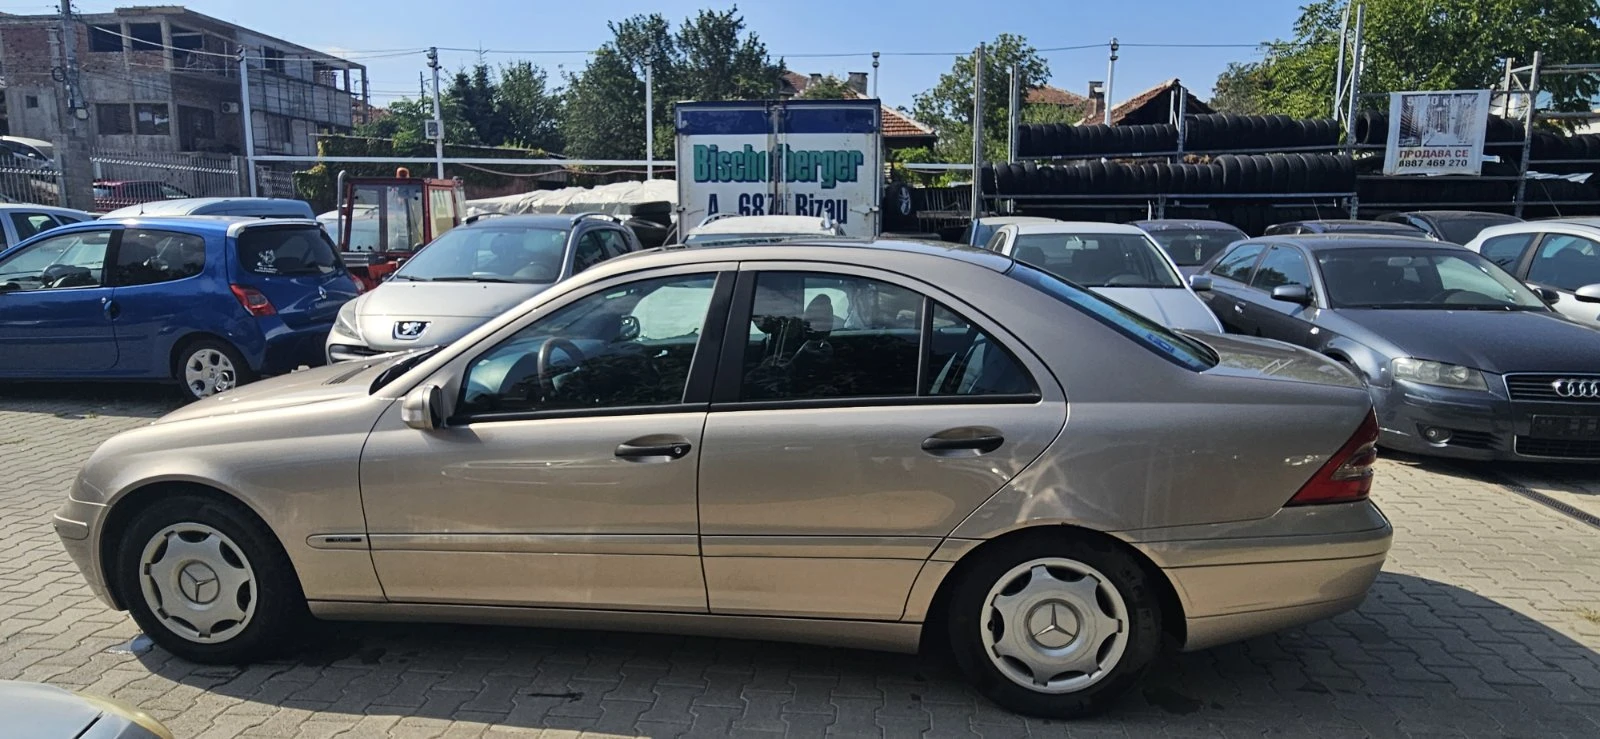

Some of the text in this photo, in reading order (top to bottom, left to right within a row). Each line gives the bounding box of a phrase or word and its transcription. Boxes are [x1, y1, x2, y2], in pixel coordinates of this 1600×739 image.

[1399, 149, 1469, 159] ПРОДАВА СЕ
[1426, 159, 1445, 167] 469
[1448, 159, 1468, 167] 270
[708, 193, 720, 217] A
[795, 193, 848, 225] Bizau
